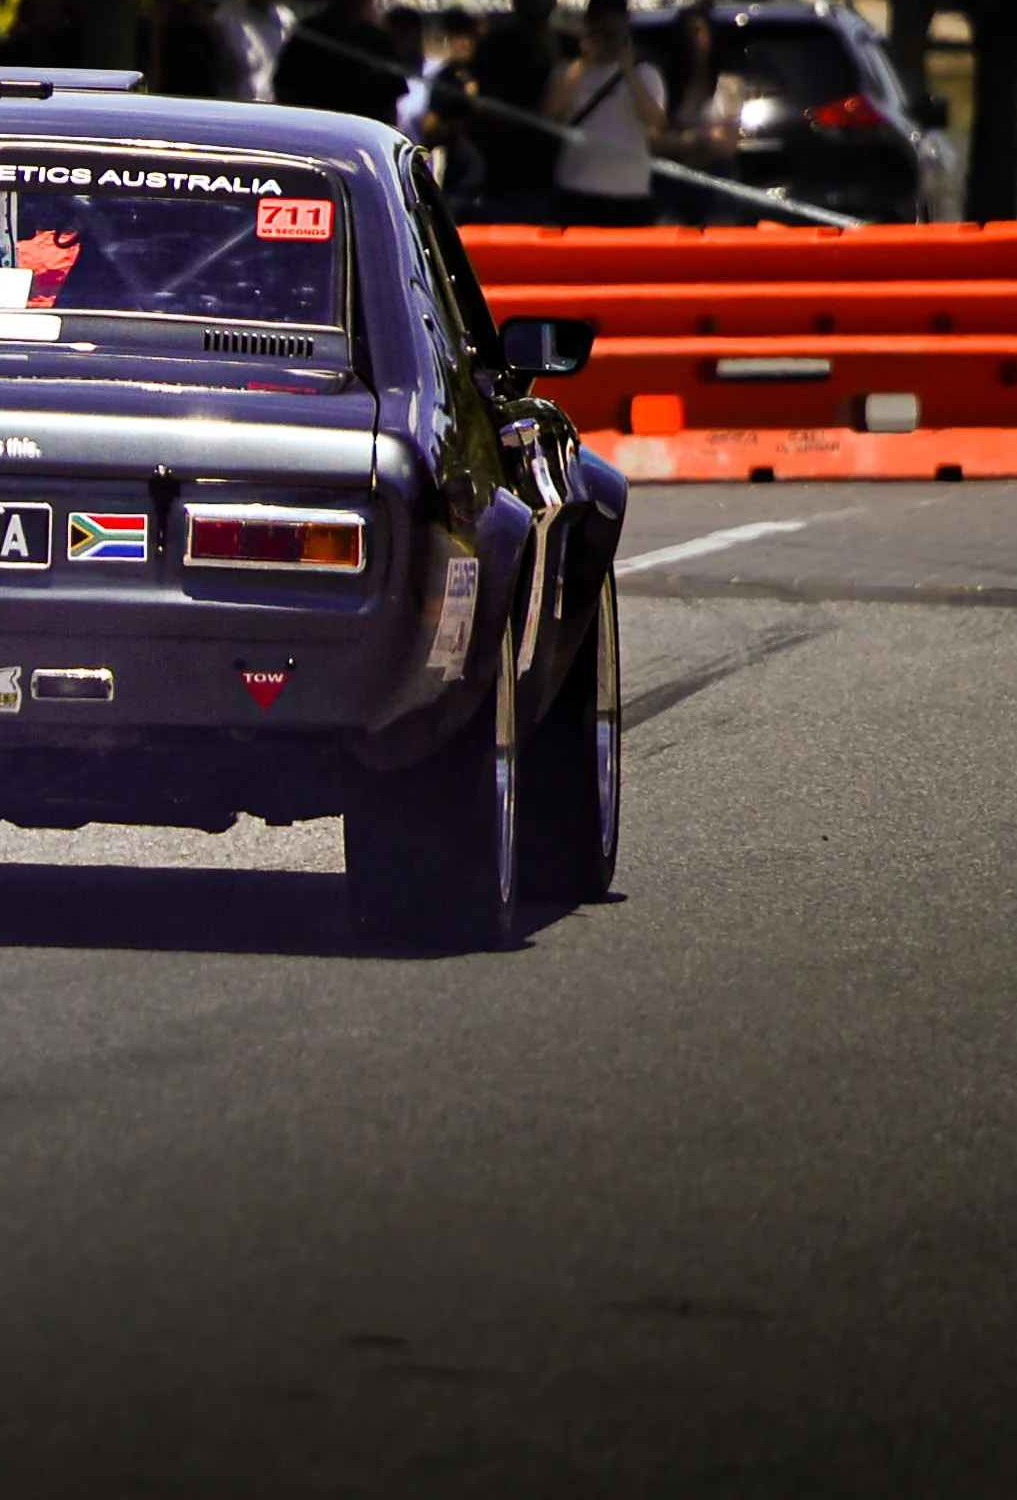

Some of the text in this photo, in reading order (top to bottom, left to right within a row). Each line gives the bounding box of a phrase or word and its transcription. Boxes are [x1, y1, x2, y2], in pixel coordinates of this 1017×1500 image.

[97, 167, 283, 196] AUSTRALIA
[261, 205, 321, 226] 711
[6, 436, 43, 459] this.
[242, 672, 284, 684] TOW
